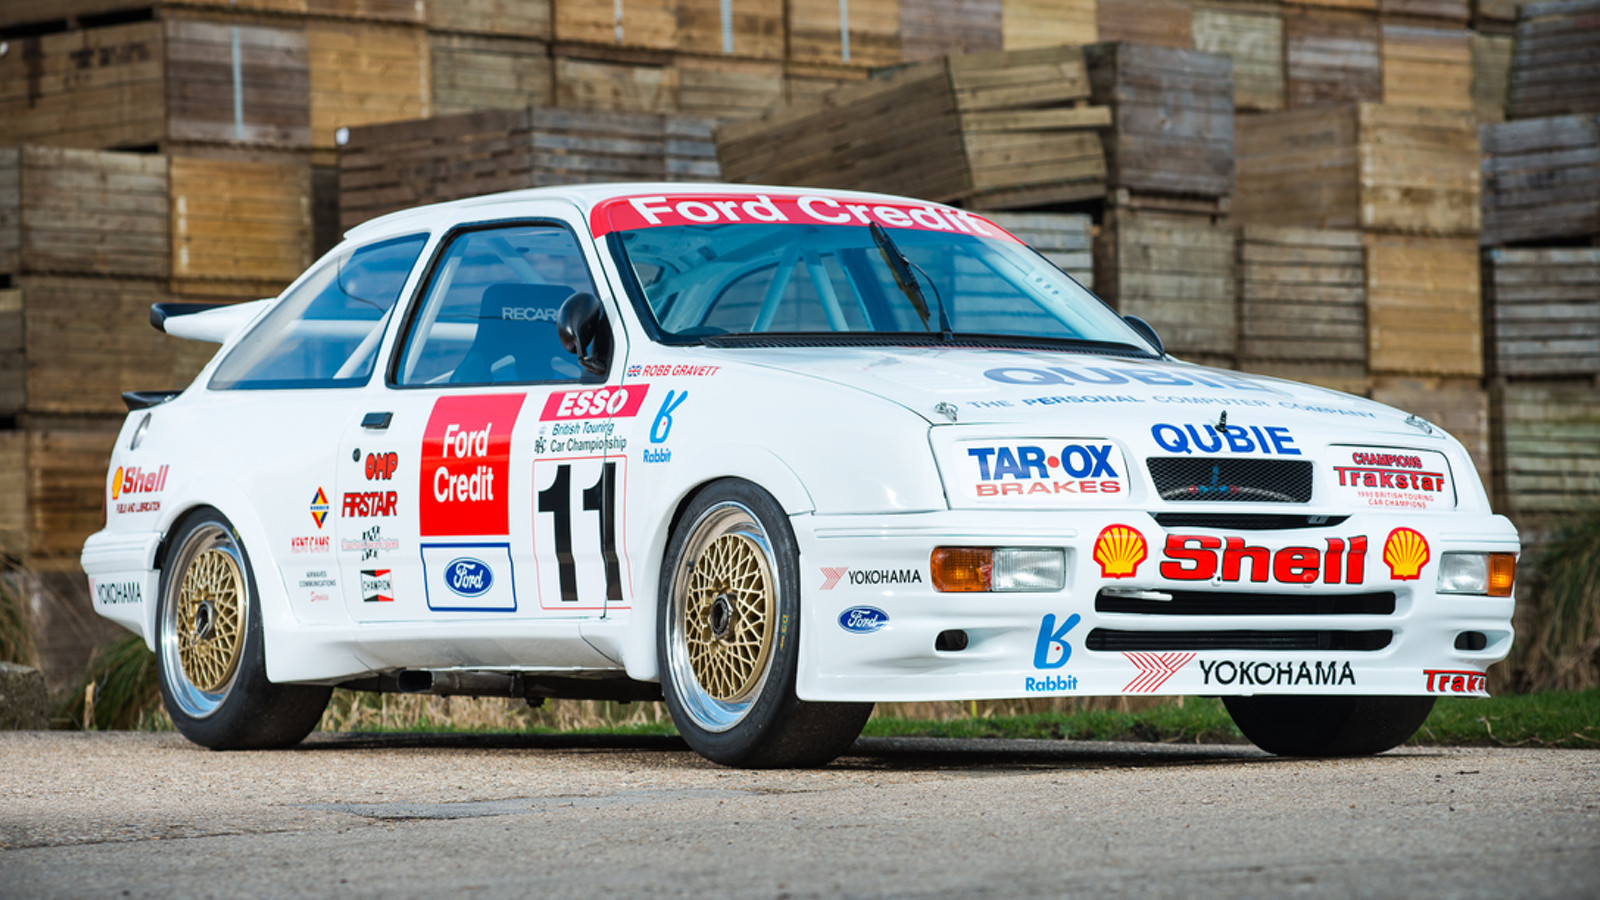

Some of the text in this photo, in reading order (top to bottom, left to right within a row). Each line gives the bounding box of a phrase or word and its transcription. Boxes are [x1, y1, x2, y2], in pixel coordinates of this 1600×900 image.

[627, 195, 992, 237] Ford Credit
[502, 307, 558, 321] RECAR
[642, 365, 721, 376] ROBB GRAVETT
[983, 366, 1274, 392] QUBIE
[556, 388, 629, 417] ESSO
[966, 395, 1377, 418] THE PERSONAL COMPUTER COMPANY
[552, 420, 614, 436] British Touring
[1150, 423, 1302, 455] QUBIE
[443, 422, 493, 458] Ford
[550, 435, 627, 453] Car Championship
[365, 451, 398, 481] OMP
[643, 448, 672, 463] Rabbit
[1352, 452, 1423, 469] CHAMPIONS
[123, 464, 169, 494] Shell
[434, 465, 494, 502] Credit
[976, 480, 1121, 497] BRAKES
[1333, 466, 1445, 492] Trakstar
[341, 491, 398, 518] FIRSTAIR
[1368, 498, 1427, 509] CAR CHAMPIONS
[1375, 491, 1403, 499] BRITISH
[1404, 493, 1434, 502] TOURING
[538, 462, 623, 602] 11
[291, 536, 330, 553] KENT CAMS
[1159, 533, 1368, 585] Shell
[363, 580, 391, 592] CHAMPION
[453, 562, 484, 589] Ford
[848, 569, 922, 585] YOKOHAMA
[96, 581, 143, 604] YOKOHAMA
[847, 609, 880, 628] Ford
[1025, 674, 1078, 692] Rabbit
[1199, 660, 1356, 687] YOKOHAMA
